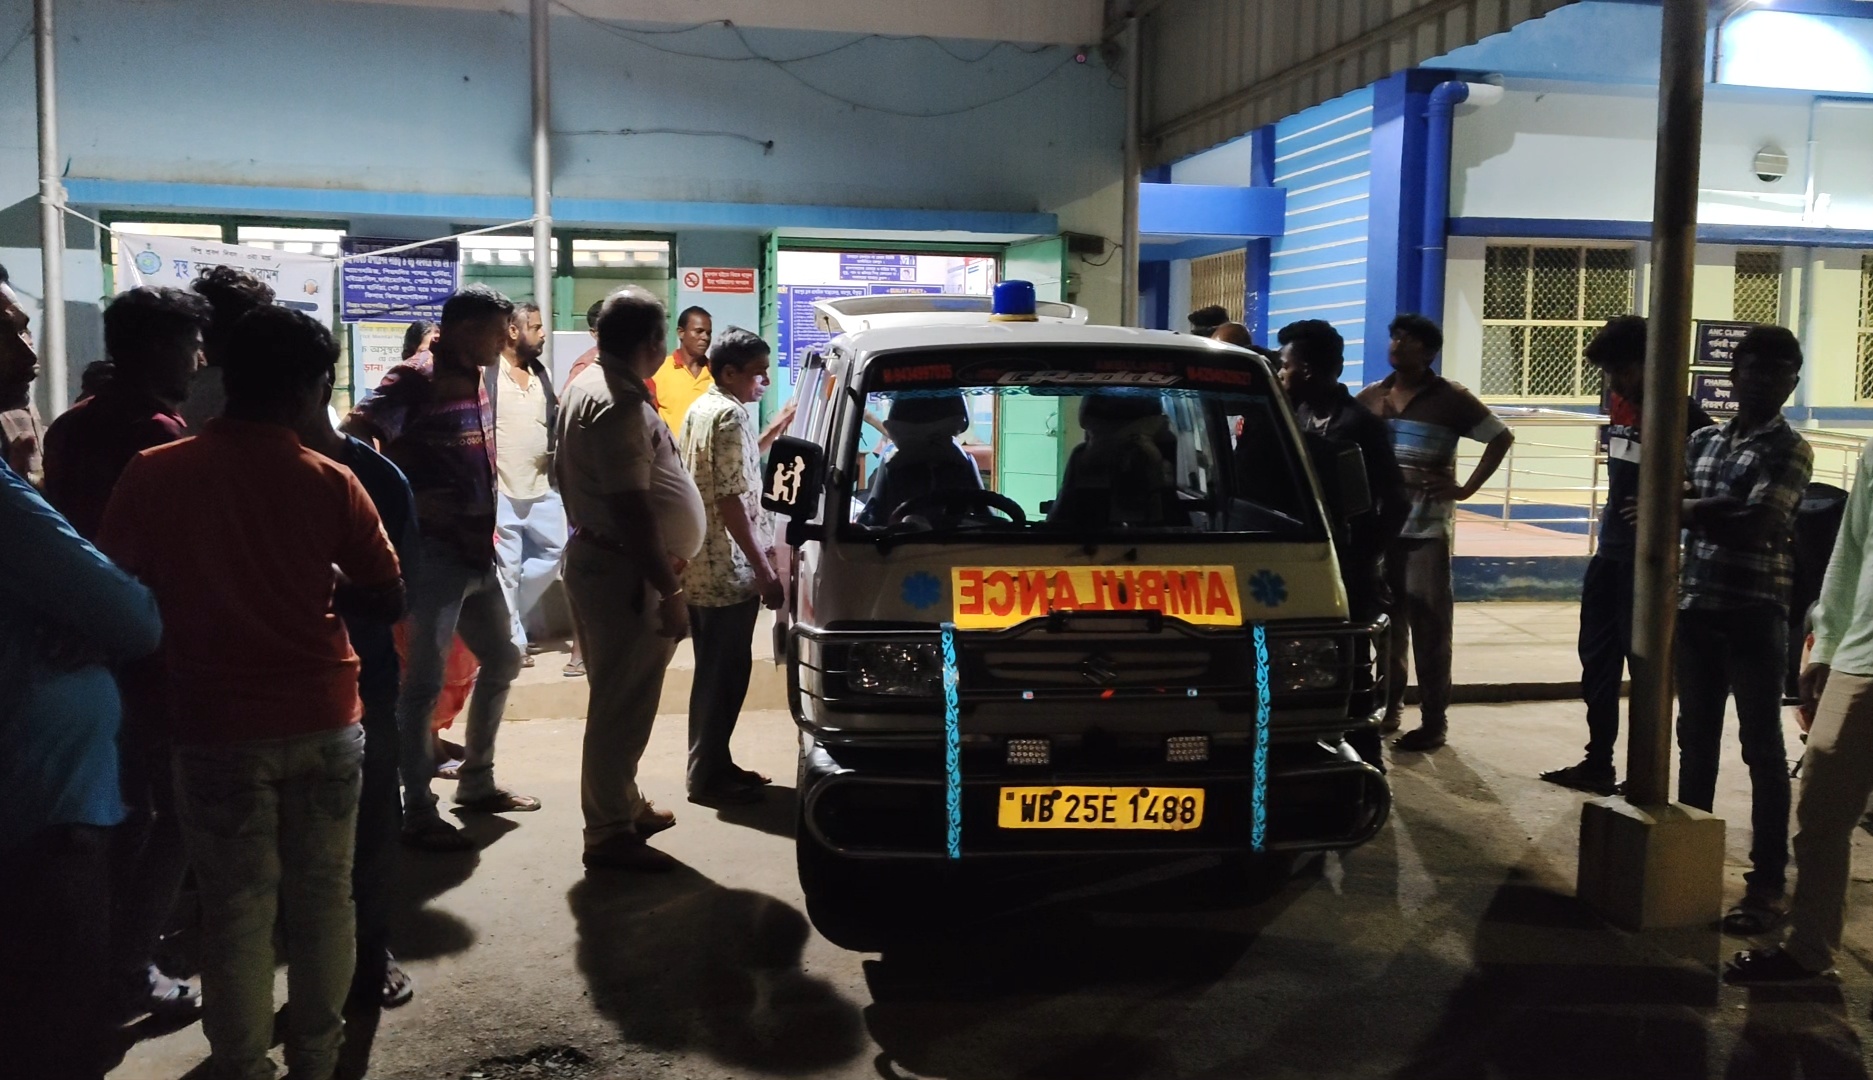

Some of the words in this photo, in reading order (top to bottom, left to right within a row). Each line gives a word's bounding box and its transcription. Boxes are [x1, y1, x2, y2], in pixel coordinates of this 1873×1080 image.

[173, 259, 189, 279] সুস্থ
[1708, 328, 1724, 336] ANC
[1724, 329, 1748, 337] CLINIC
[1021, 794, 1055, 823] WB
[1065, 794, 1116, 823] 25E
[1129, 795, 1196, 824] 1488
